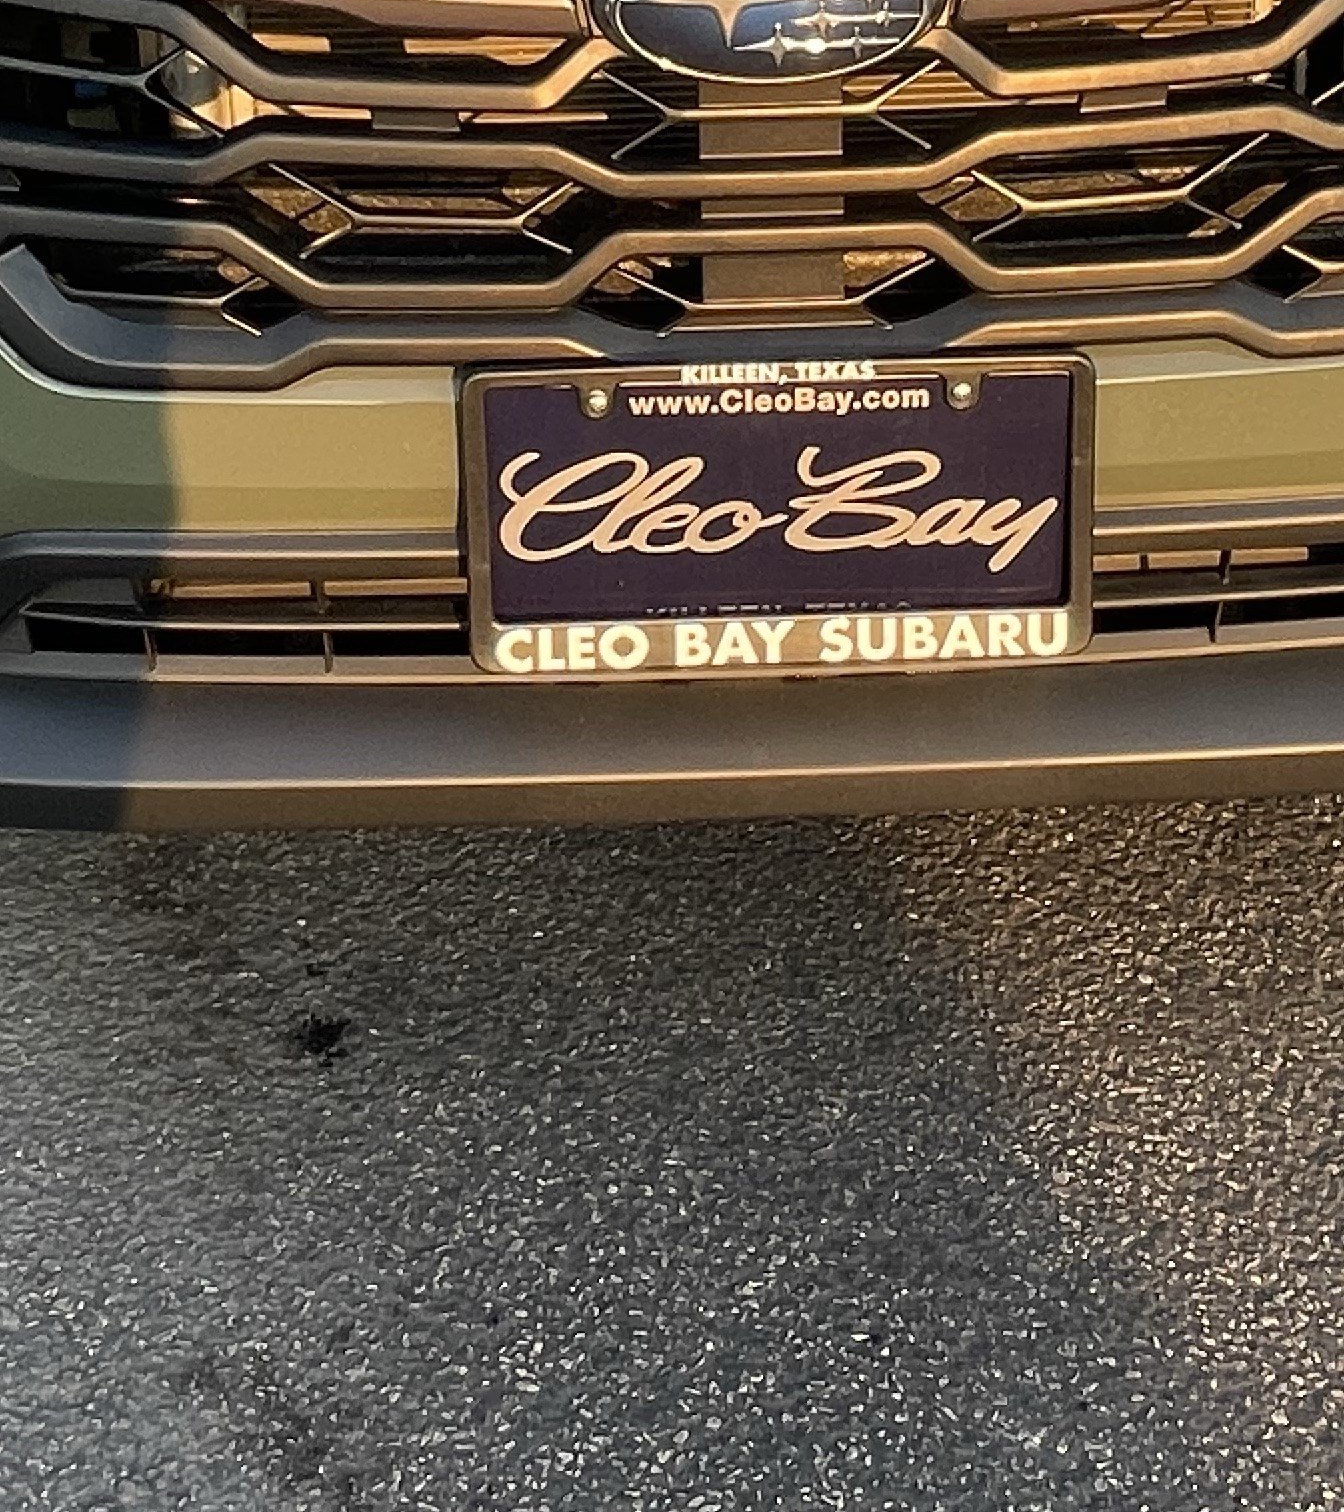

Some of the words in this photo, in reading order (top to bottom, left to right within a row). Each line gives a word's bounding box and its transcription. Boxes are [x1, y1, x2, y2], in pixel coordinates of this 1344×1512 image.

[681, 362, 787, 386] KILLEEN,
[794, 360, 877, 380] TEXAS
[628, 387, 931, 416] www.CleoBay.com
[498, 451, 788, 563] Cleo
[785, 445, 1059, 573] Bay
[494, 625, 650, 674] CLEO
[673, 620, 797, 667] BAY
[819, 610, 1070, 662] SUBARU
